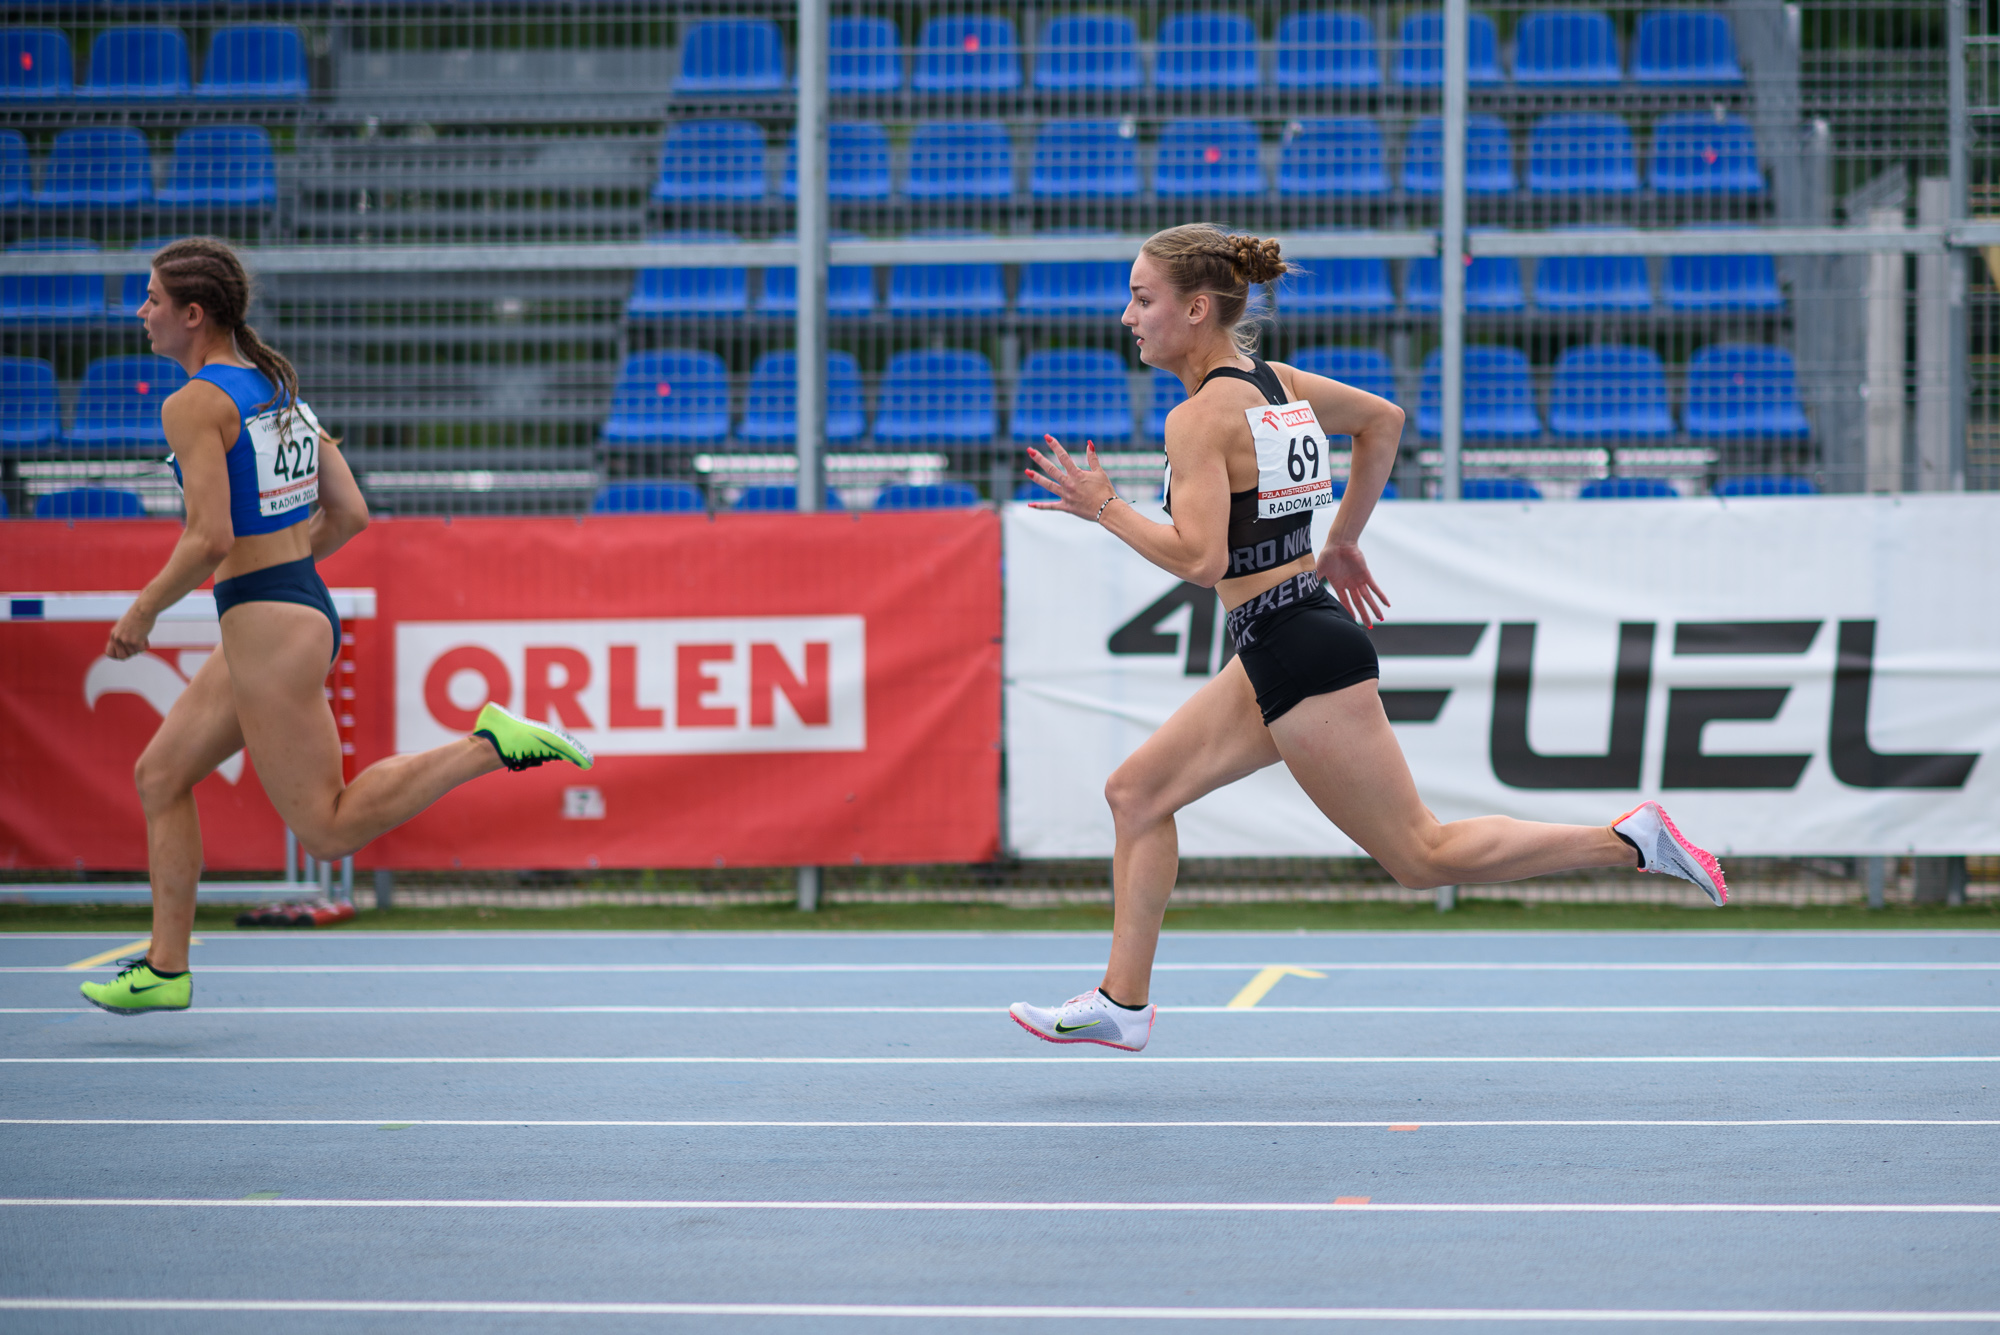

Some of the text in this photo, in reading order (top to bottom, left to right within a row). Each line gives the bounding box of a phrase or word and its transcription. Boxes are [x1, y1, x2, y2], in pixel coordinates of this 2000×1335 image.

[1283, 409, 1314, 426] ORLEN
[274, 436, 316, 482] 422
[1287, 435, 1319, 483] 69
[1262, 490, 1281, 499] PZLA
[1281, 483, 1320, 496] MISTRZOSTWA
[270, 493, 302, 511] RADOM
[1269, 497, 1312, 514] RADOM
[423, 641, 830, 734] ORLEN
